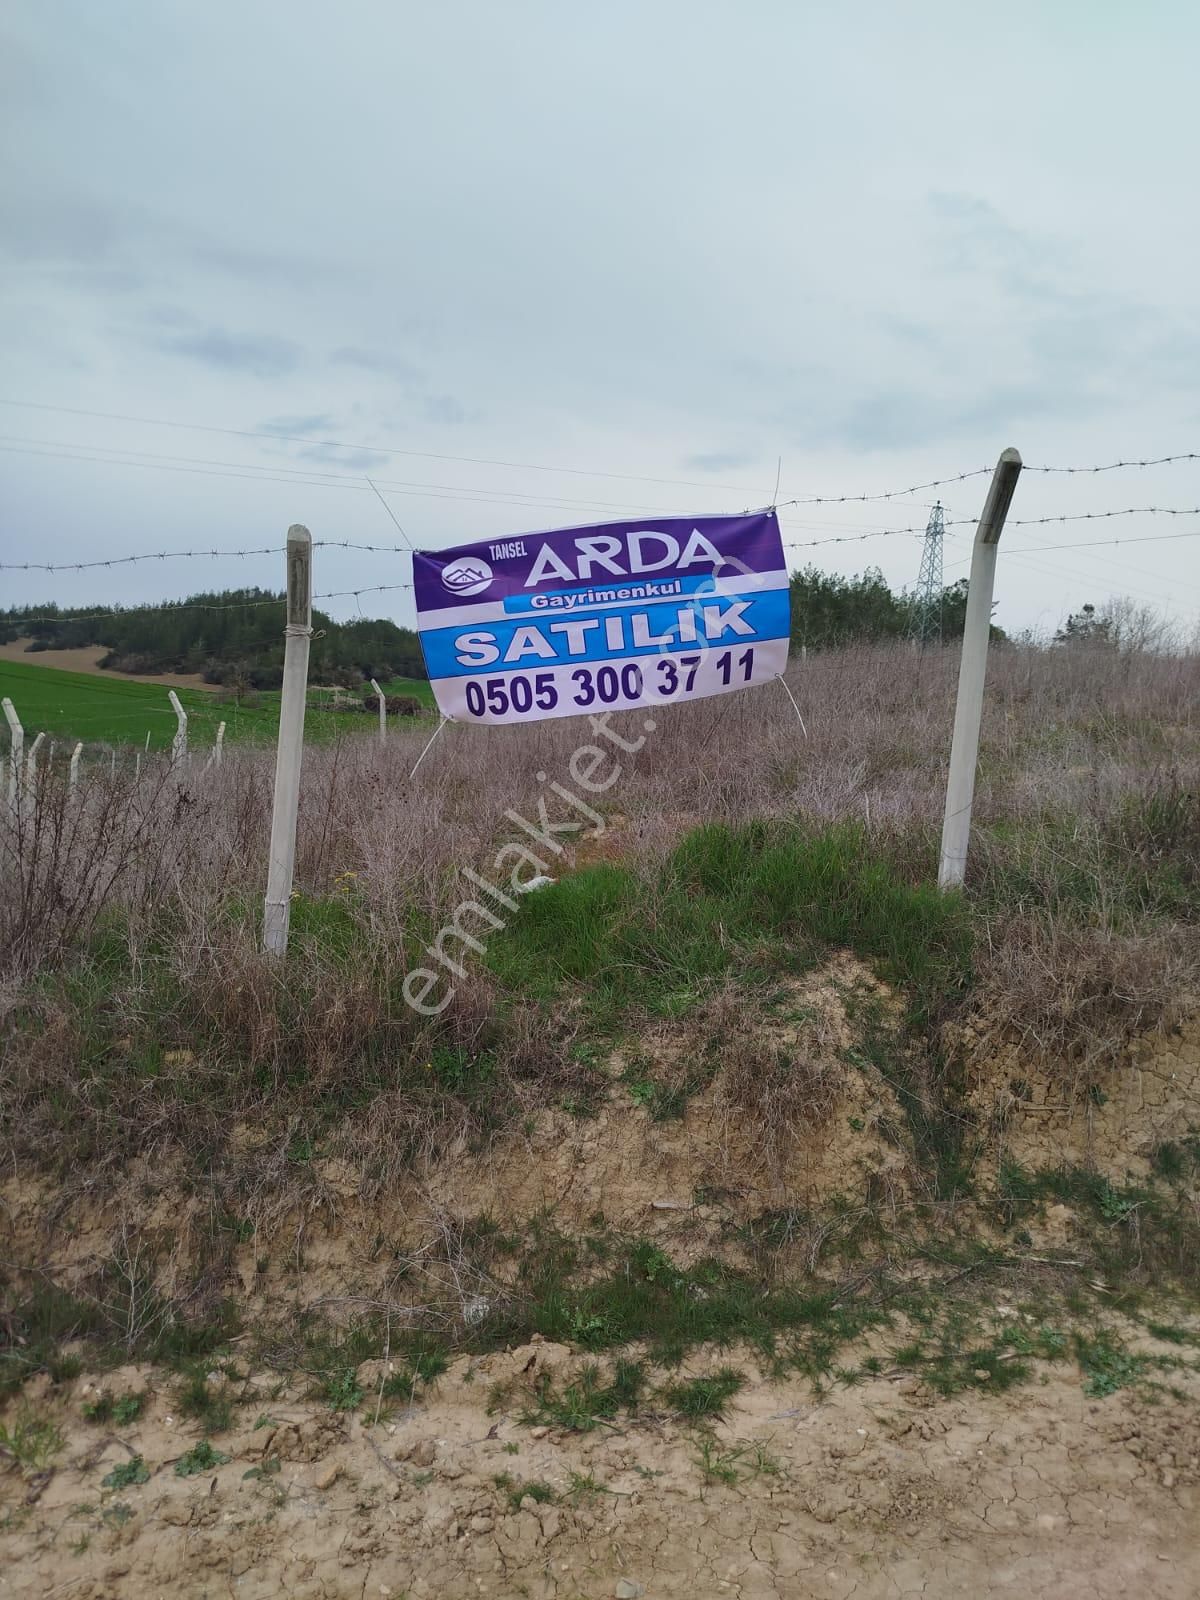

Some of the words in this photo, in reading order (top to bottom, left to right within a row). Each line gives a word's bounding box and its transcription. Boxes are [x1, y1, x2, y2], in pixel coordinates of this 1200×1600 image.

[489, 541, 527, 561] TANSEL
[524, 528, 726, 588] ARDA
[530, 579, 682, 610] Gayrimenkul
[454, 600, 757, 667] SATILIK
[465, 672, 559, 717] 0505
[571, 663, 643, 706] 300
[657, 656, 701, 696] 37
[716, 648, 754, 686] 11
